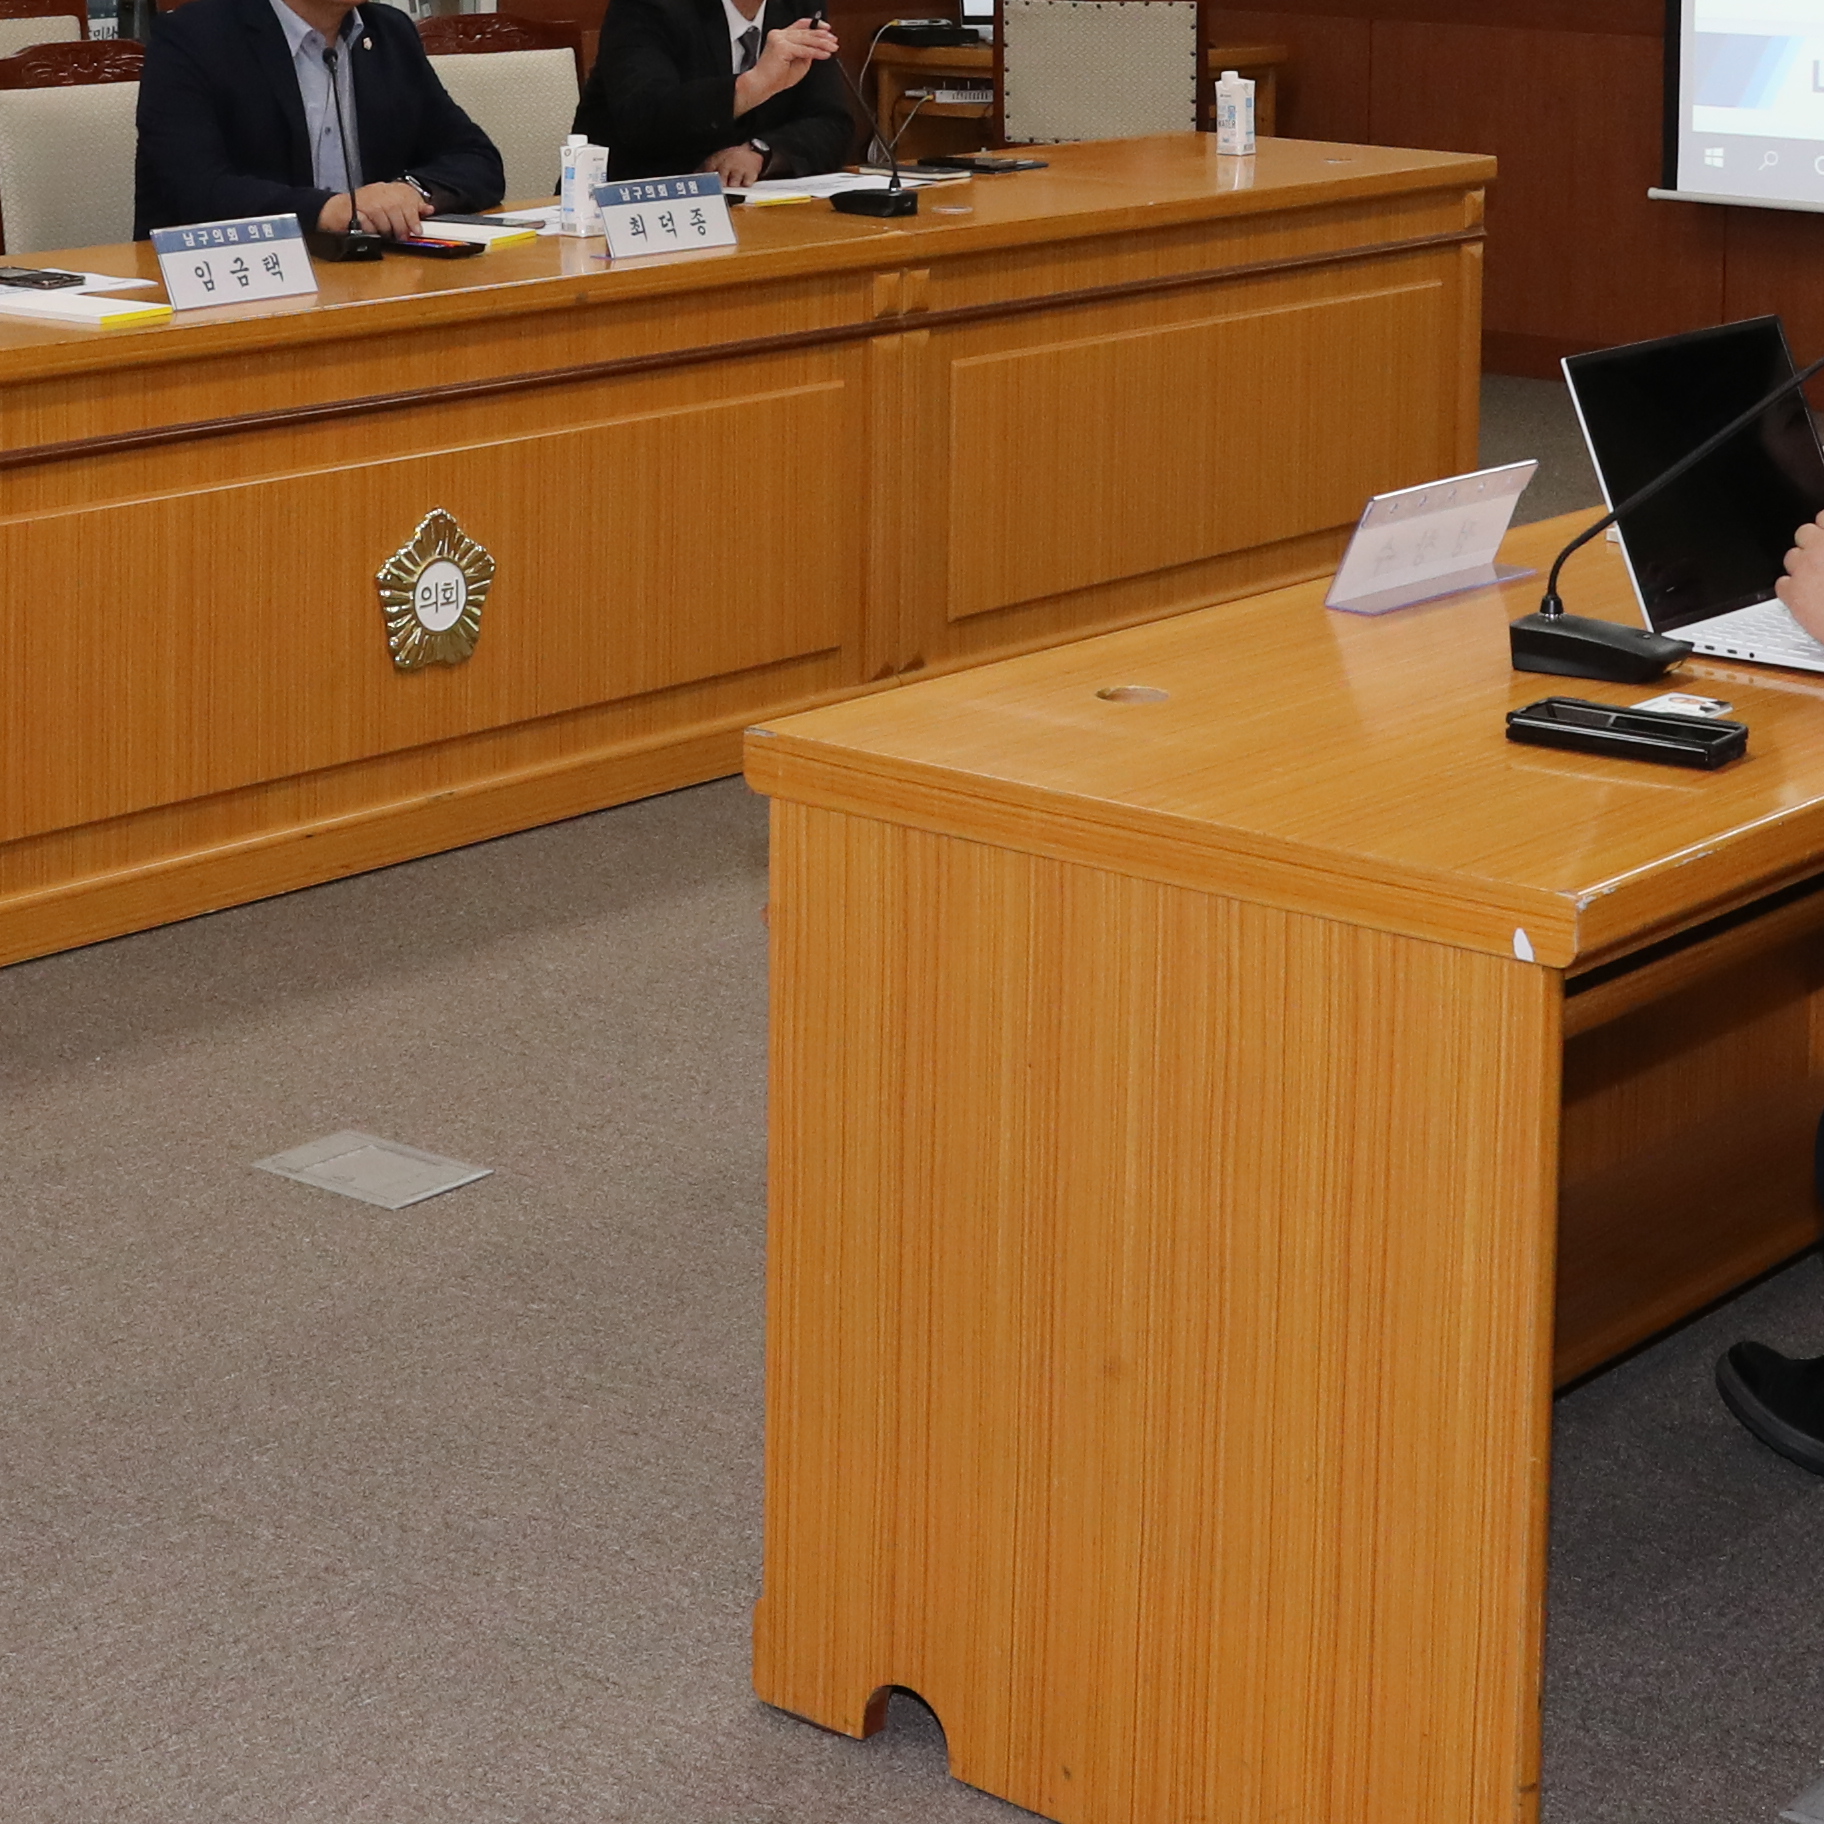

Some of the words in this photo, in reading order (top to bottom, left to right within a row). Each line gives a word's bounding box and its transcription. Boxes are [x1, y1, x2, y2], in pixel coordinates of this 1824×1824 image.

[619, 183, 669, 202] 남구의회
[675, 180, 700, 196] 의원
[182, 227, 239, 247] 남구의회
[248, 223, 275, 239] 의원
[630, 208, 707, 242] 최덕종
[194, 252, 284, 292] 임금택
[419, 579, 460, 613] 의회
